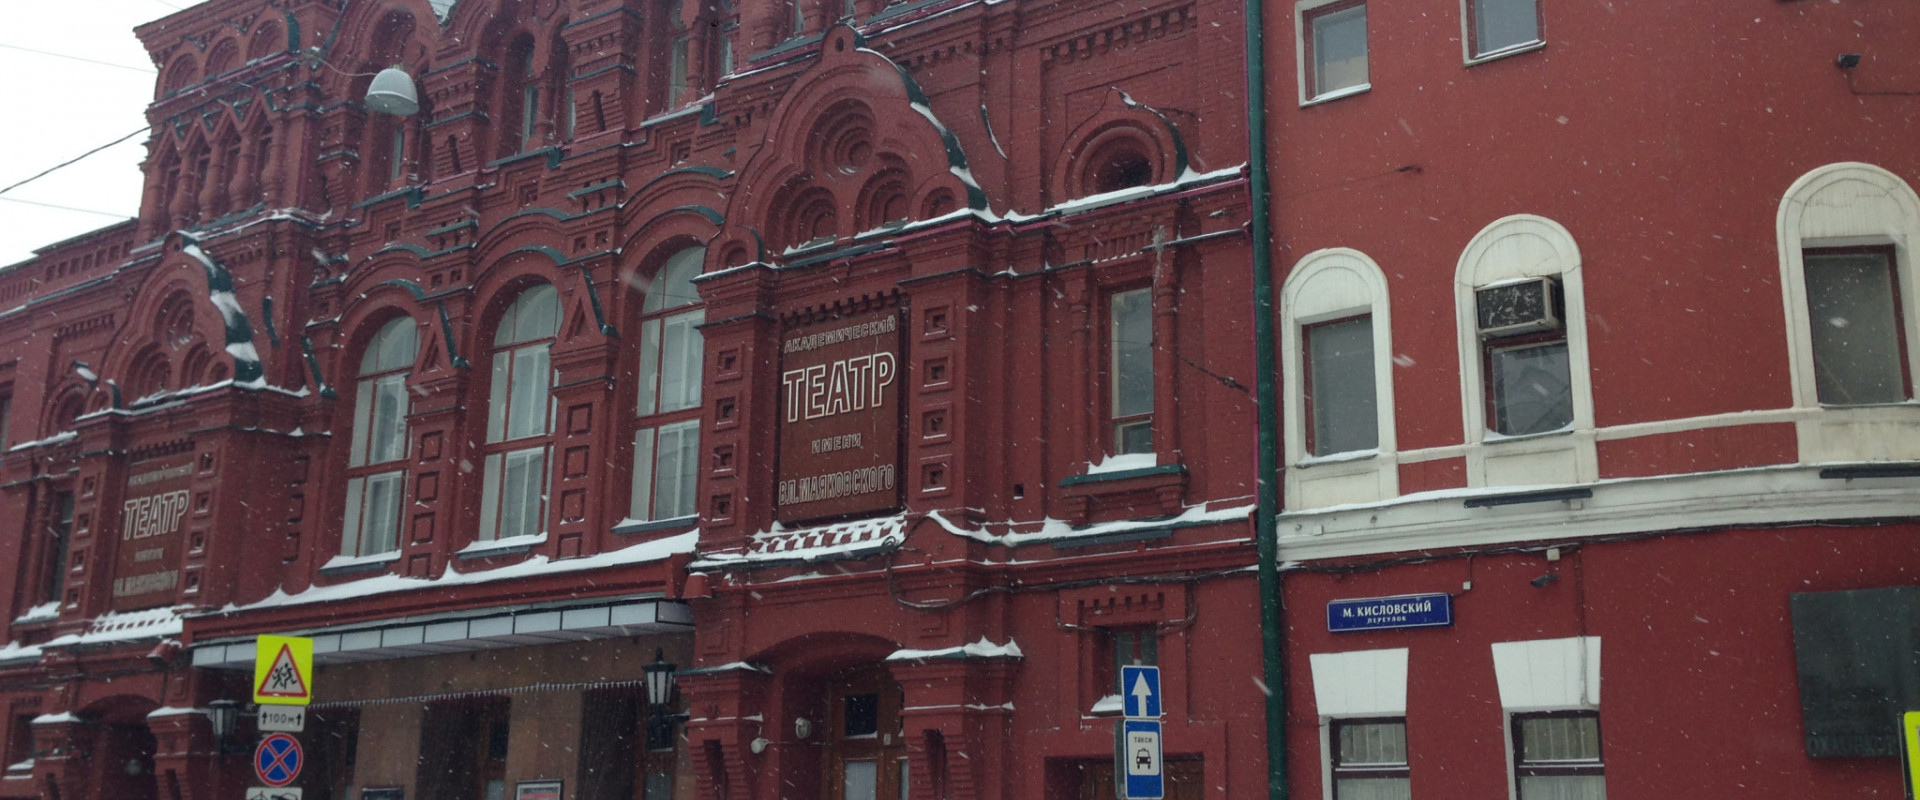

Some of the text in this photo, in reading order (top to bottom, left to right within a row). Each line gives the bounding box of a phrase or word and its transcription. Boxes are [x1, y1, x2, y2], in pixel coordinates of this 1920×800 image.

[784, 315, 896, 353] АКАДЕМИЧЕСКИЙ
[783, 352, 896, 423] ТЕАТР
[811, 433, 862, 454] ИМЕНИ
[123, 489, 190, 541] ТЕАТР
[1343, 600, 1432, 618] М. КИСЛОВСКИЙ
[1366, 616, 1407, 625] ПЕРЕУЛОК
